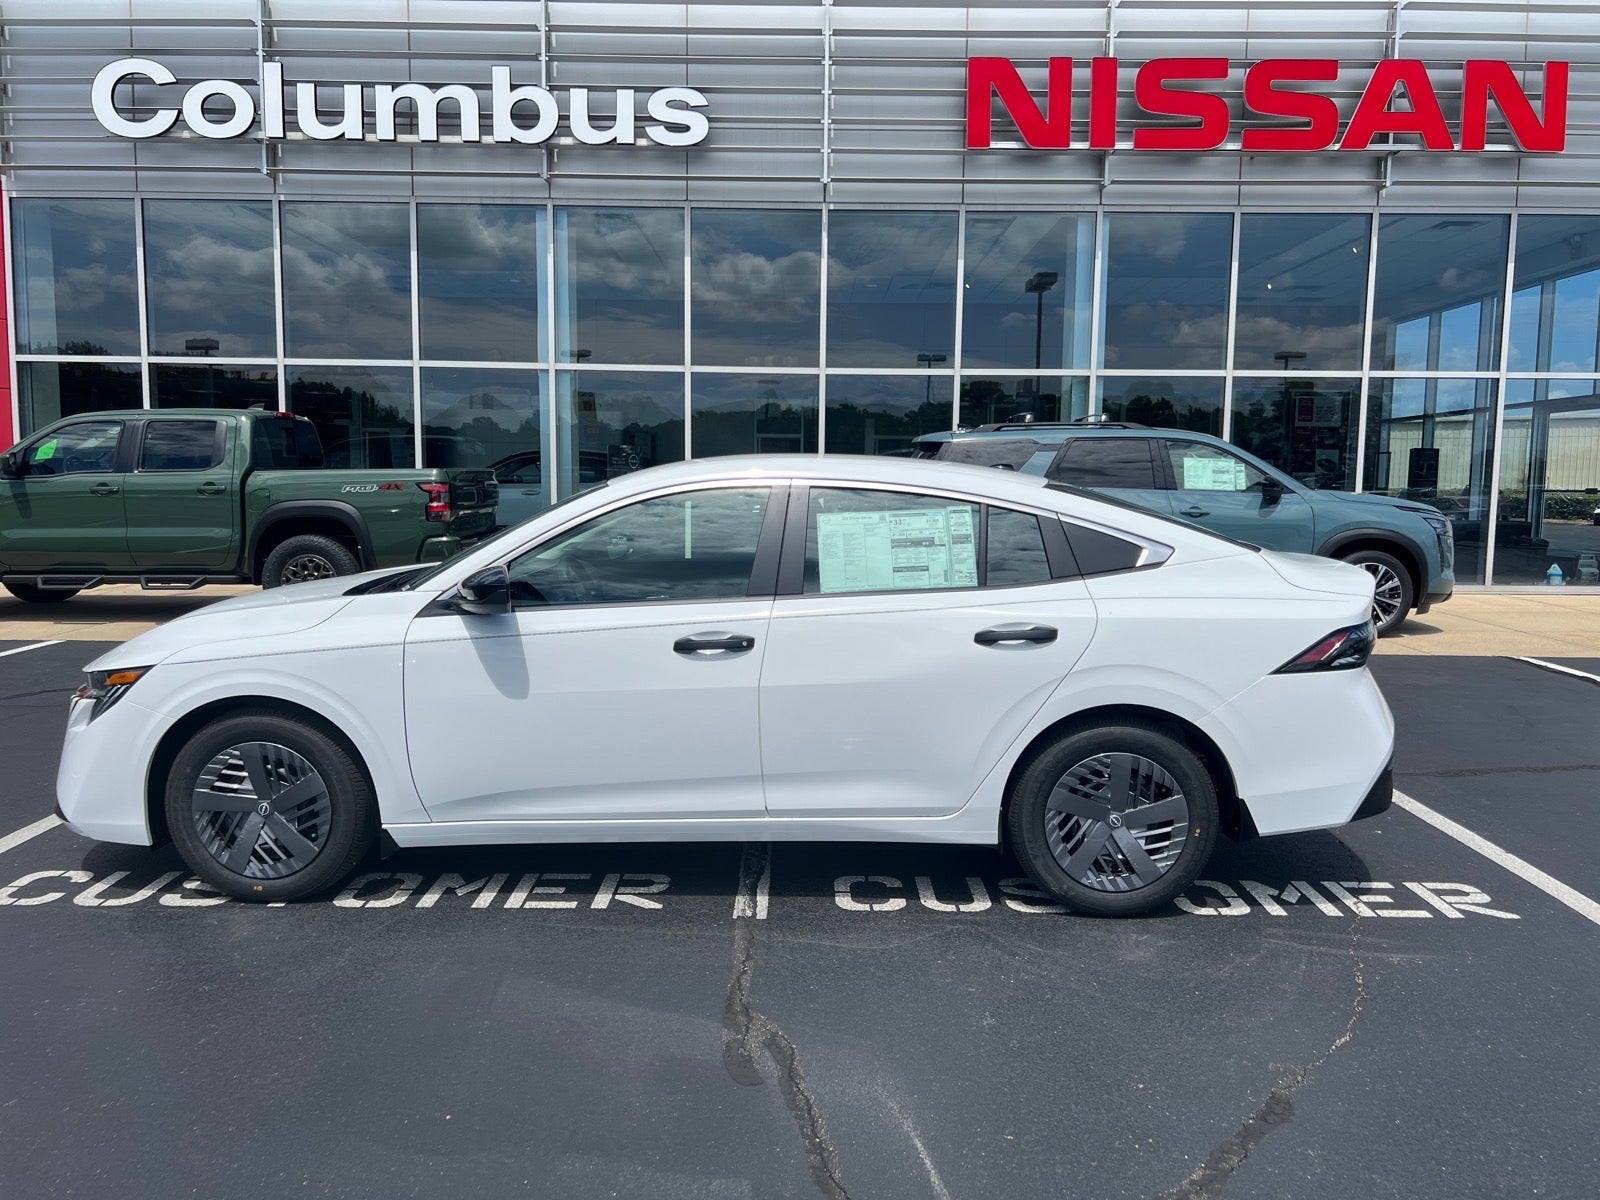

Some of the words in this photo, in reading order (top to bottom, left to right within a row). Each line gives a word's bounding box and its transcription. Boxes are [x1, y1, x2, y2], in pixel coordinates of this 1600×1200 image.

[91, 57, 710, 148] Columbus
[966, 56, 1569, 153] NISSAN
[0, 870, 671, 909] CUSOMER
[834, 875, 1520, 919] CUSOMER
